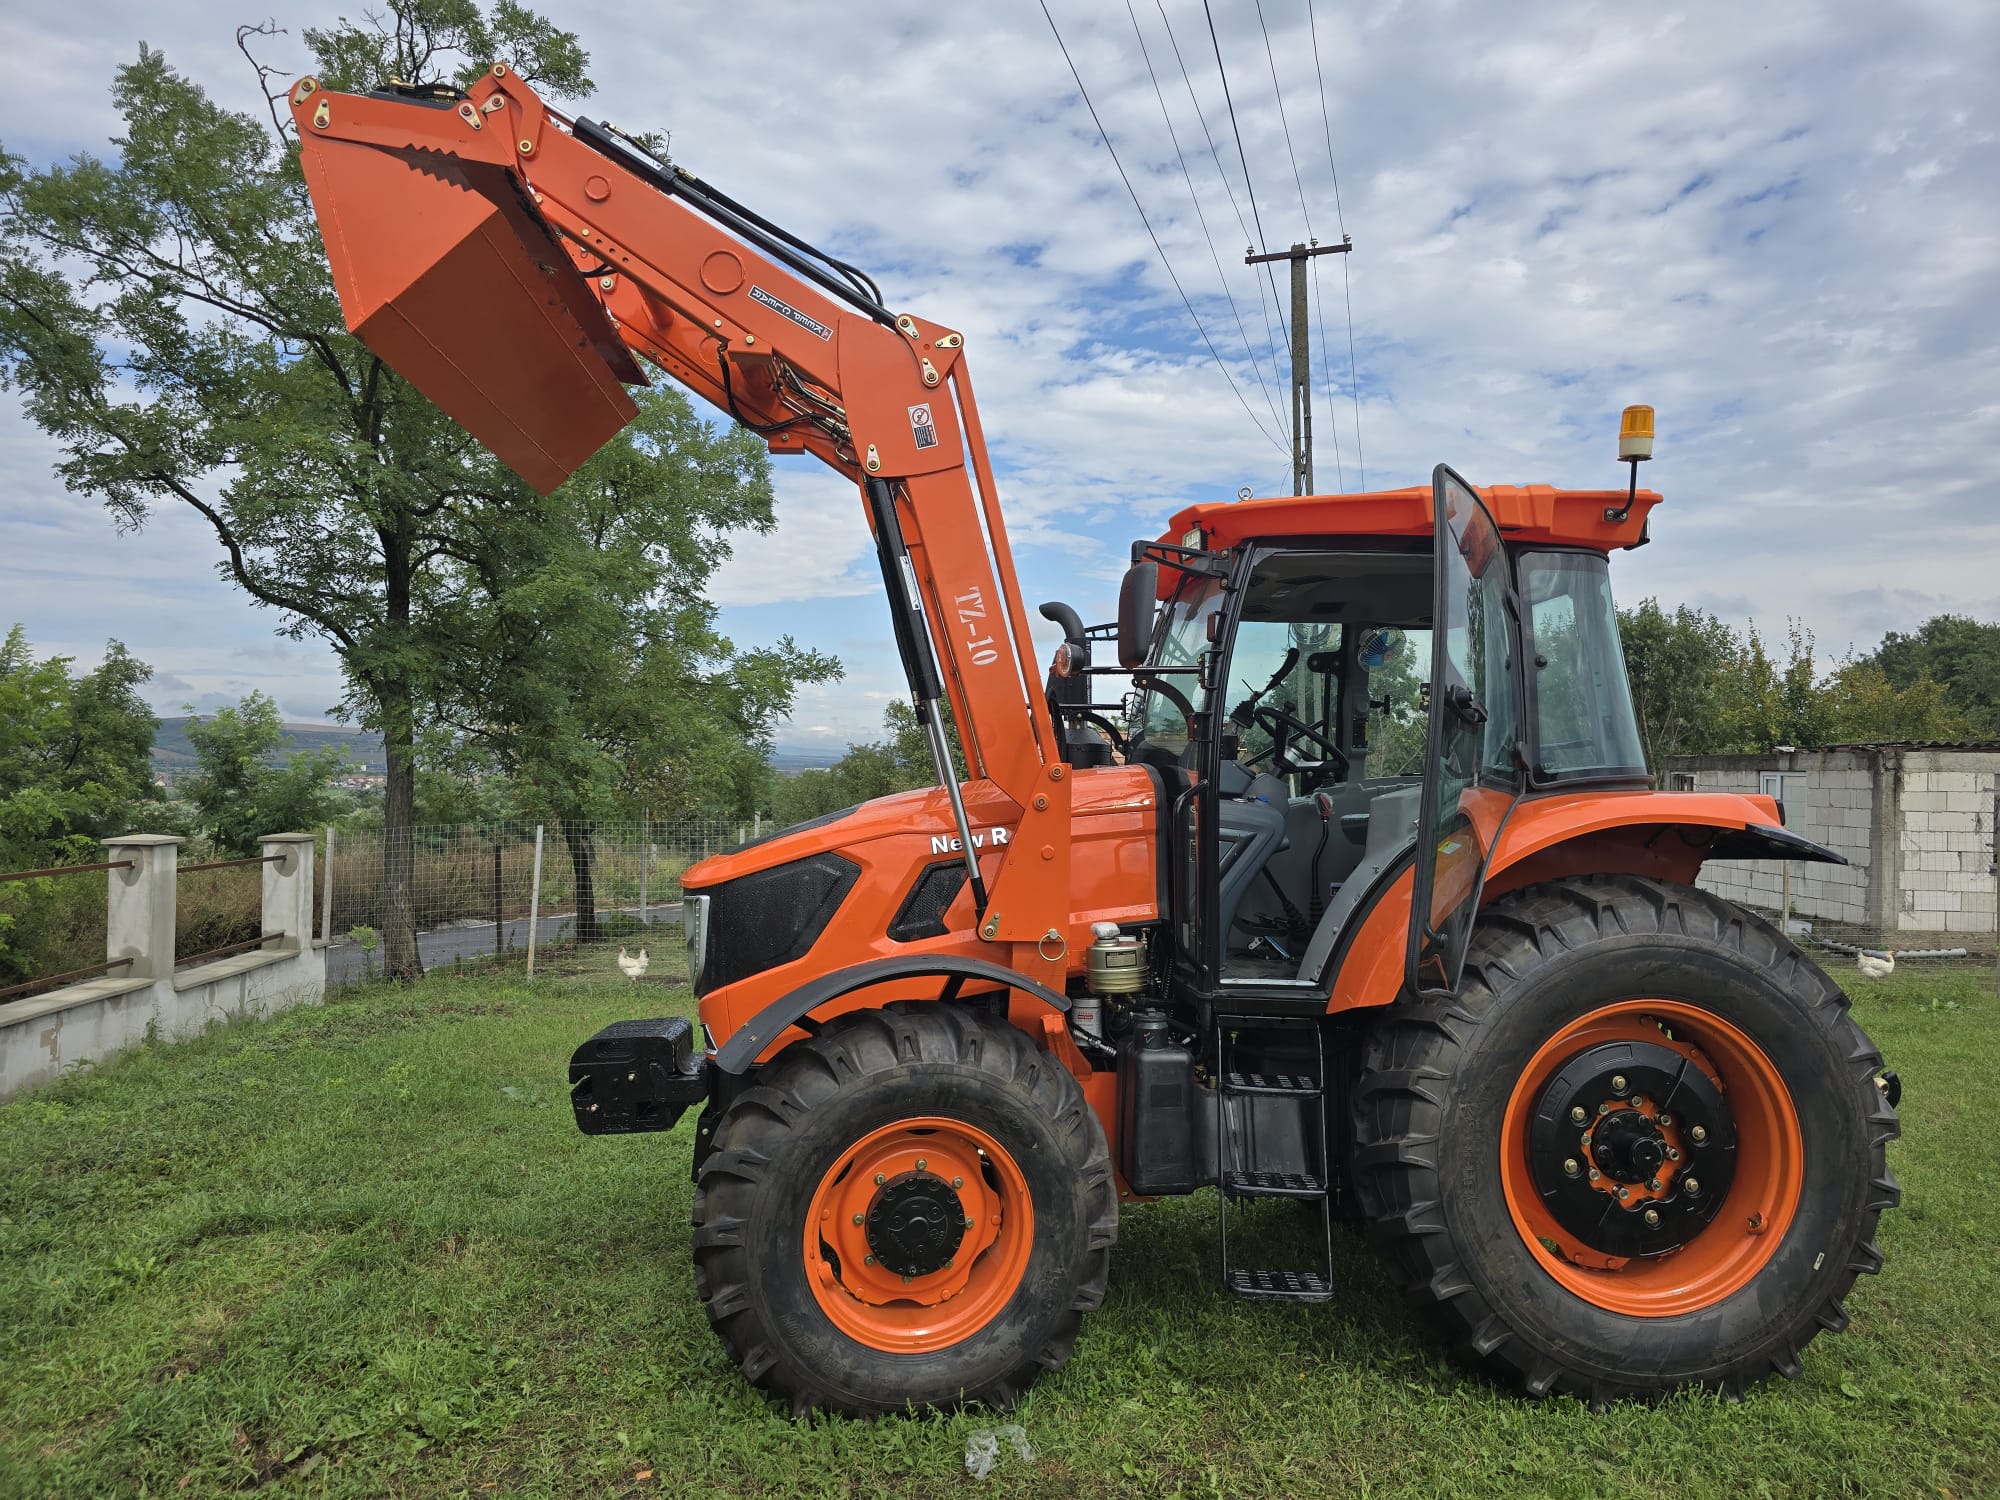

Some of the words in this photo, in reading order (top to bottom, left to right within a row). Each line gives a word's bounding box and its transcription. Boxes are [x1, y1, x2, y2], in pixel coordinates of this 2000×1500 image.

[752, 289, 791, 315] CLEAR
[793, 311, 823, 334] KEEP
[954, 586, 998, 666] TZ-10
